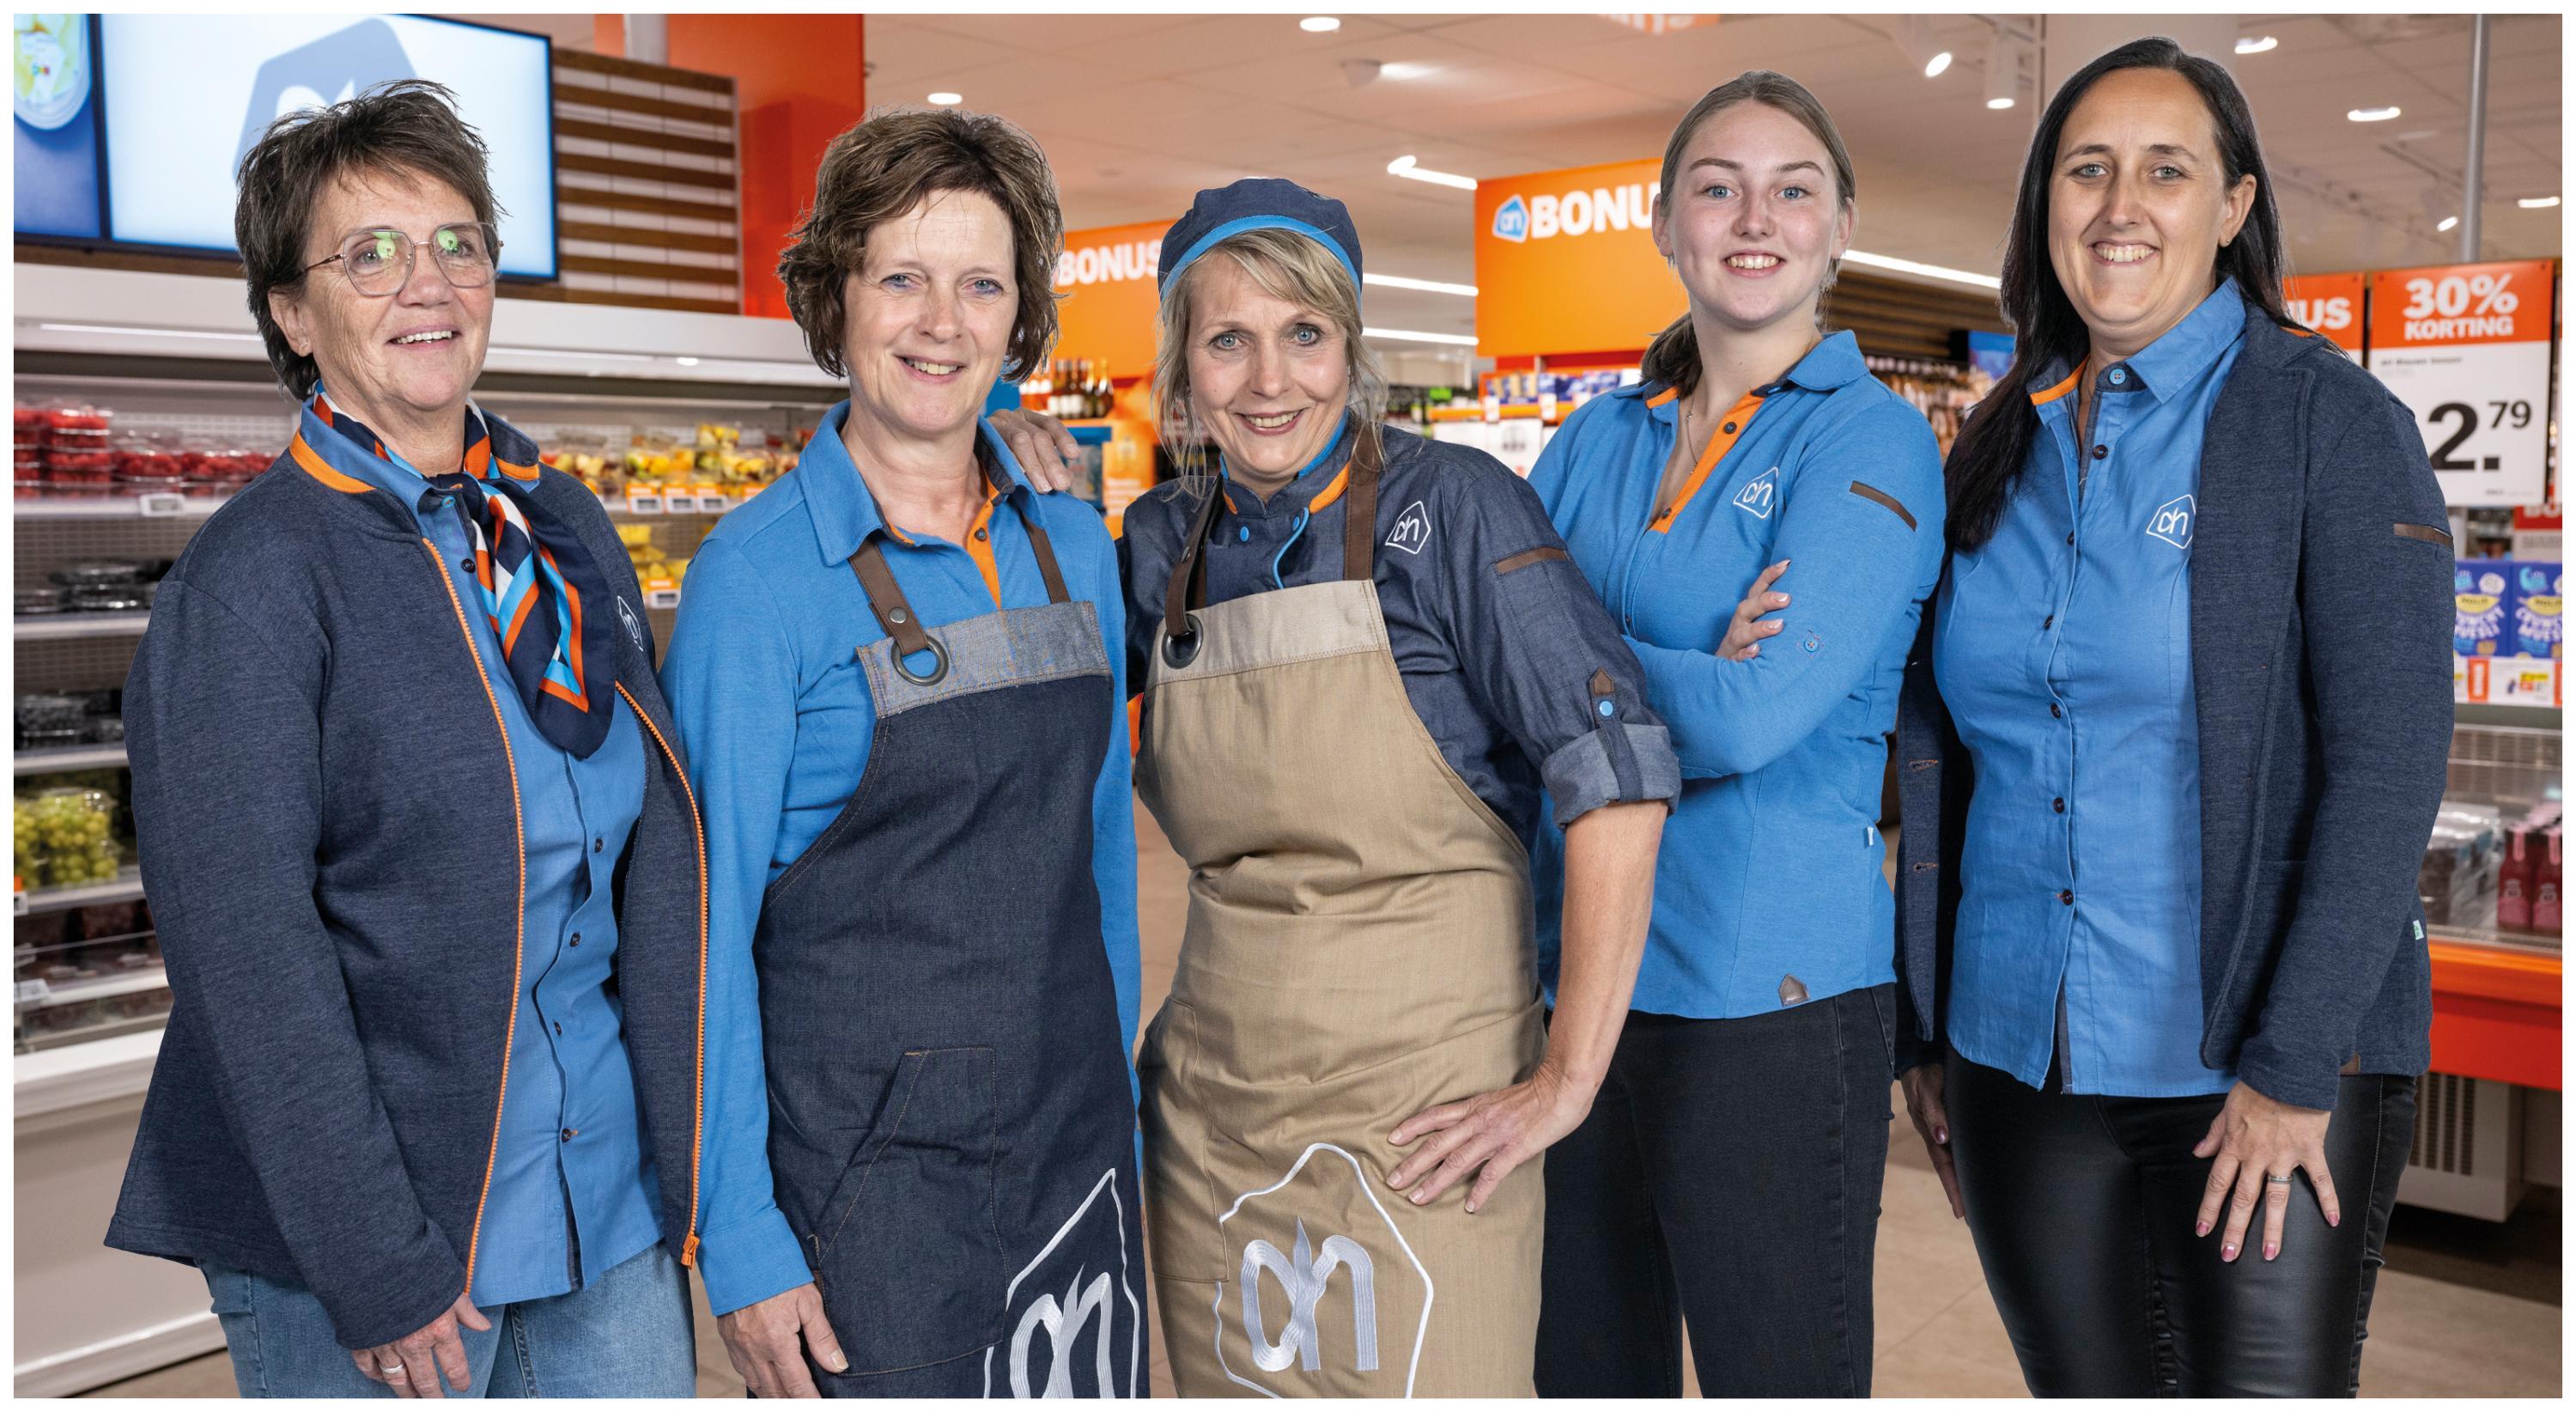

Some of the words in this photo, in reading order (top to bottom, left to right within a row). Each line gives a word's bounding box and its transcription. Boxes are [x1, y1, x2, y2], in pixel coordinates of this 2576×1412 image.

[1531, 181, 1662, 239] BONU
[1056, 239, 1162, 287] BONUS
[2403, 273, 2519, 320] 30%
[2405, 316, 2513, 340] KORTING
